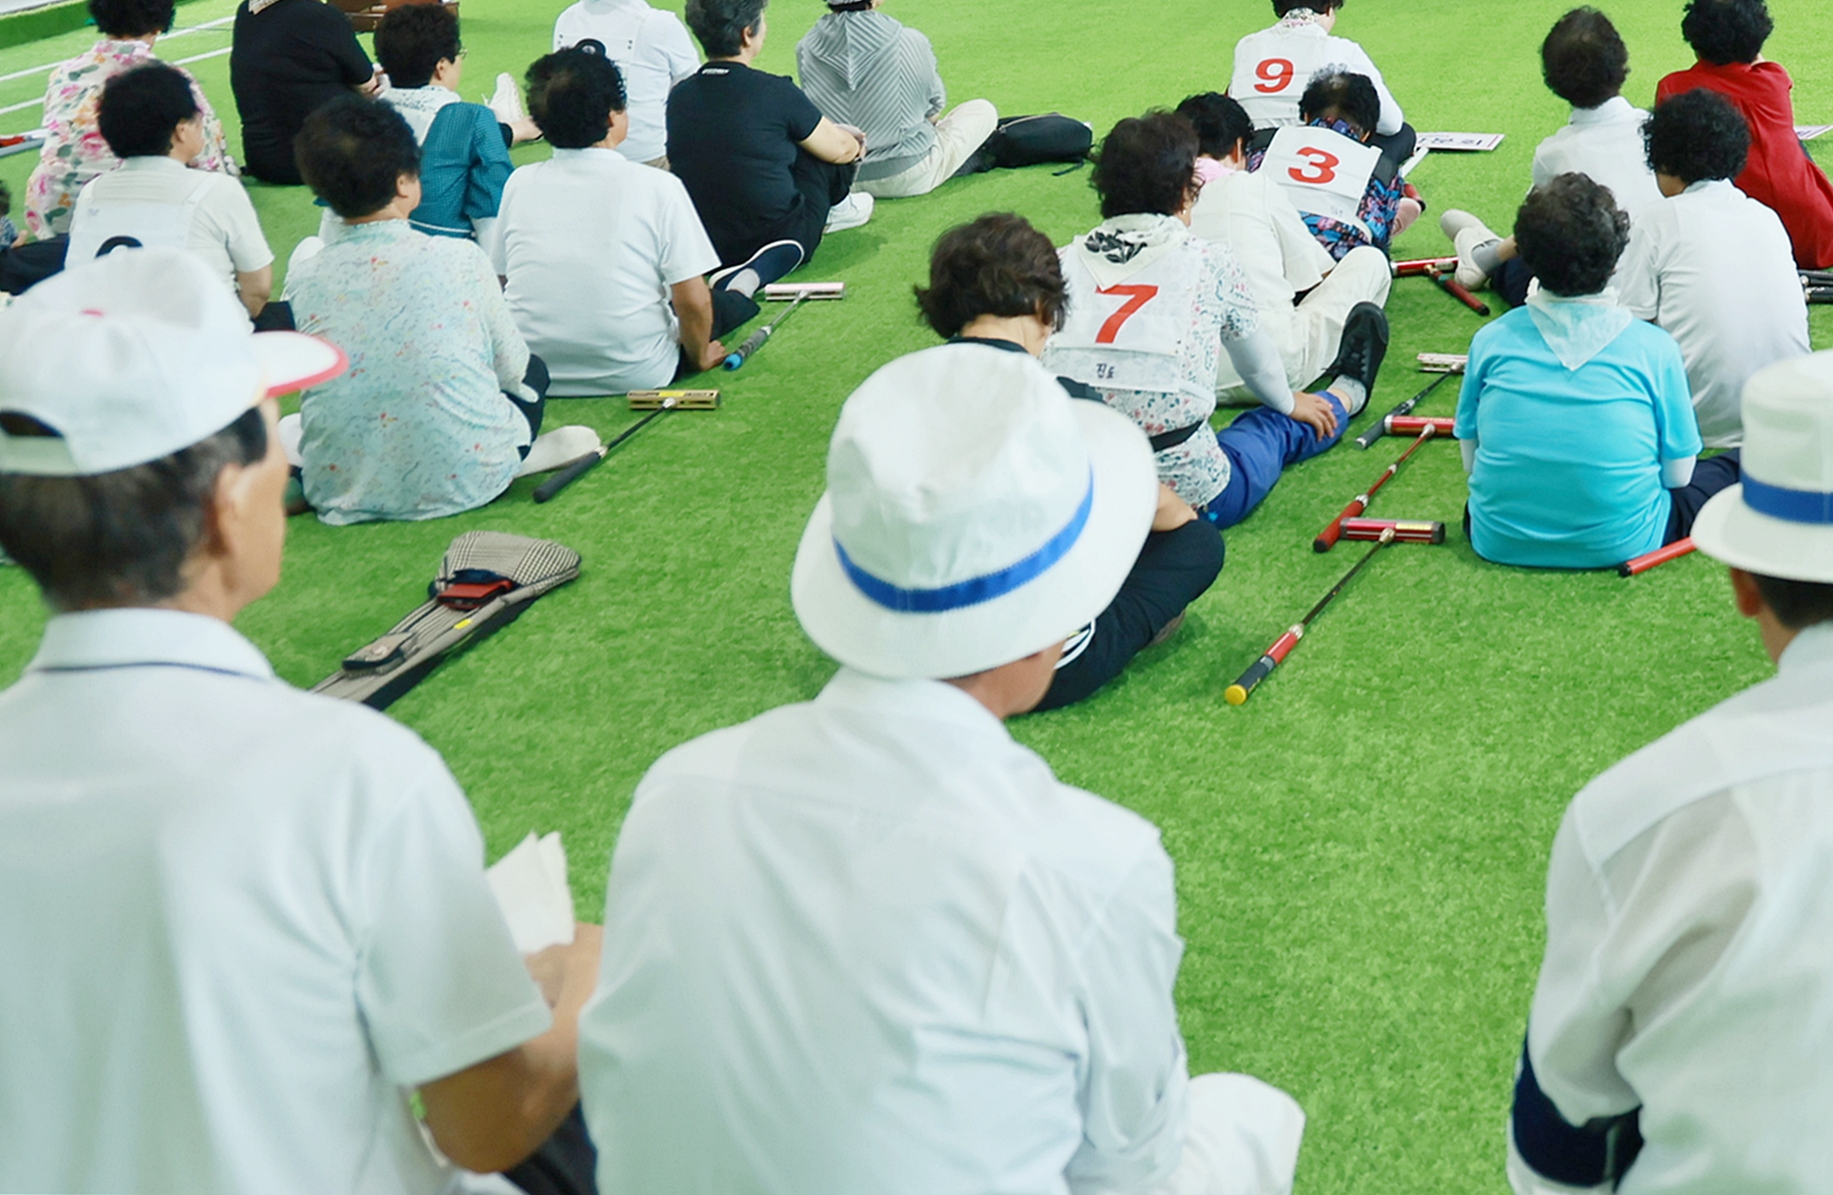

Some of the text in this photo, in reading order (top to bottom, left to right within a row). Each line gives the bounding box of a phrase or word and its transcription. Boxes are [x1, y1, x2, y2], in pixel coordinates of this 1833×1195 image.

[1254, 58, 1294, 94] 9
[1288, 146, 1340, 184] 3
[1094, 284, 1159, 344] 7
